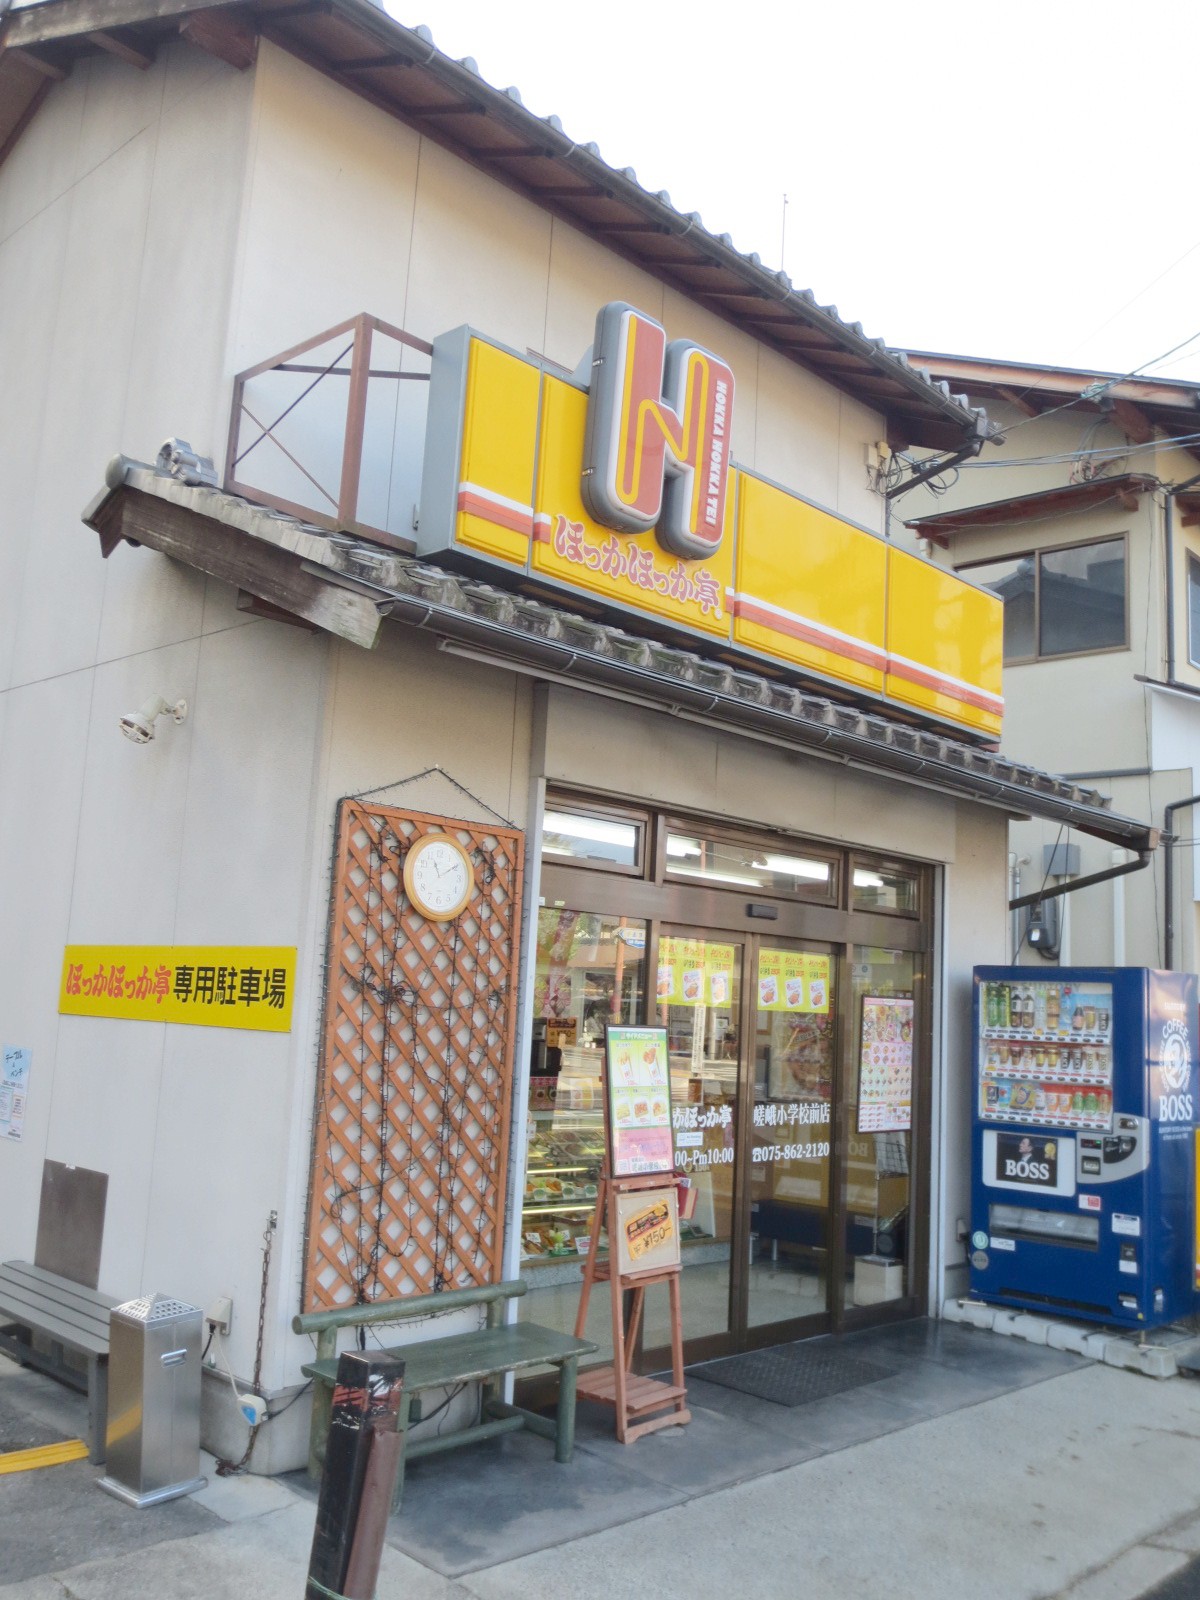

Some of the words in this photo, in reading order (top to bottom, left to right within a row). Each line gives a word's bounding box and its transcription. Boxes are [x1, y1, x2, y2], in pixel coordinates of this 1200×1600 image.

[713, 380, 728, 437] HOKKA
[708, 439, 723, 495] HOKKA
[705, 498, 719, 527] TEI
[554, 514, 721, 614] ほっかほっか亭
[1162, 1017, 1189, 1040] COFFEE
[753, 1102, 831, 1127] 嵯峨小学校前店
[1159, 1095, 1193, 1122] BOSS
[1005, 1159, 1050, 1180] BOSS
